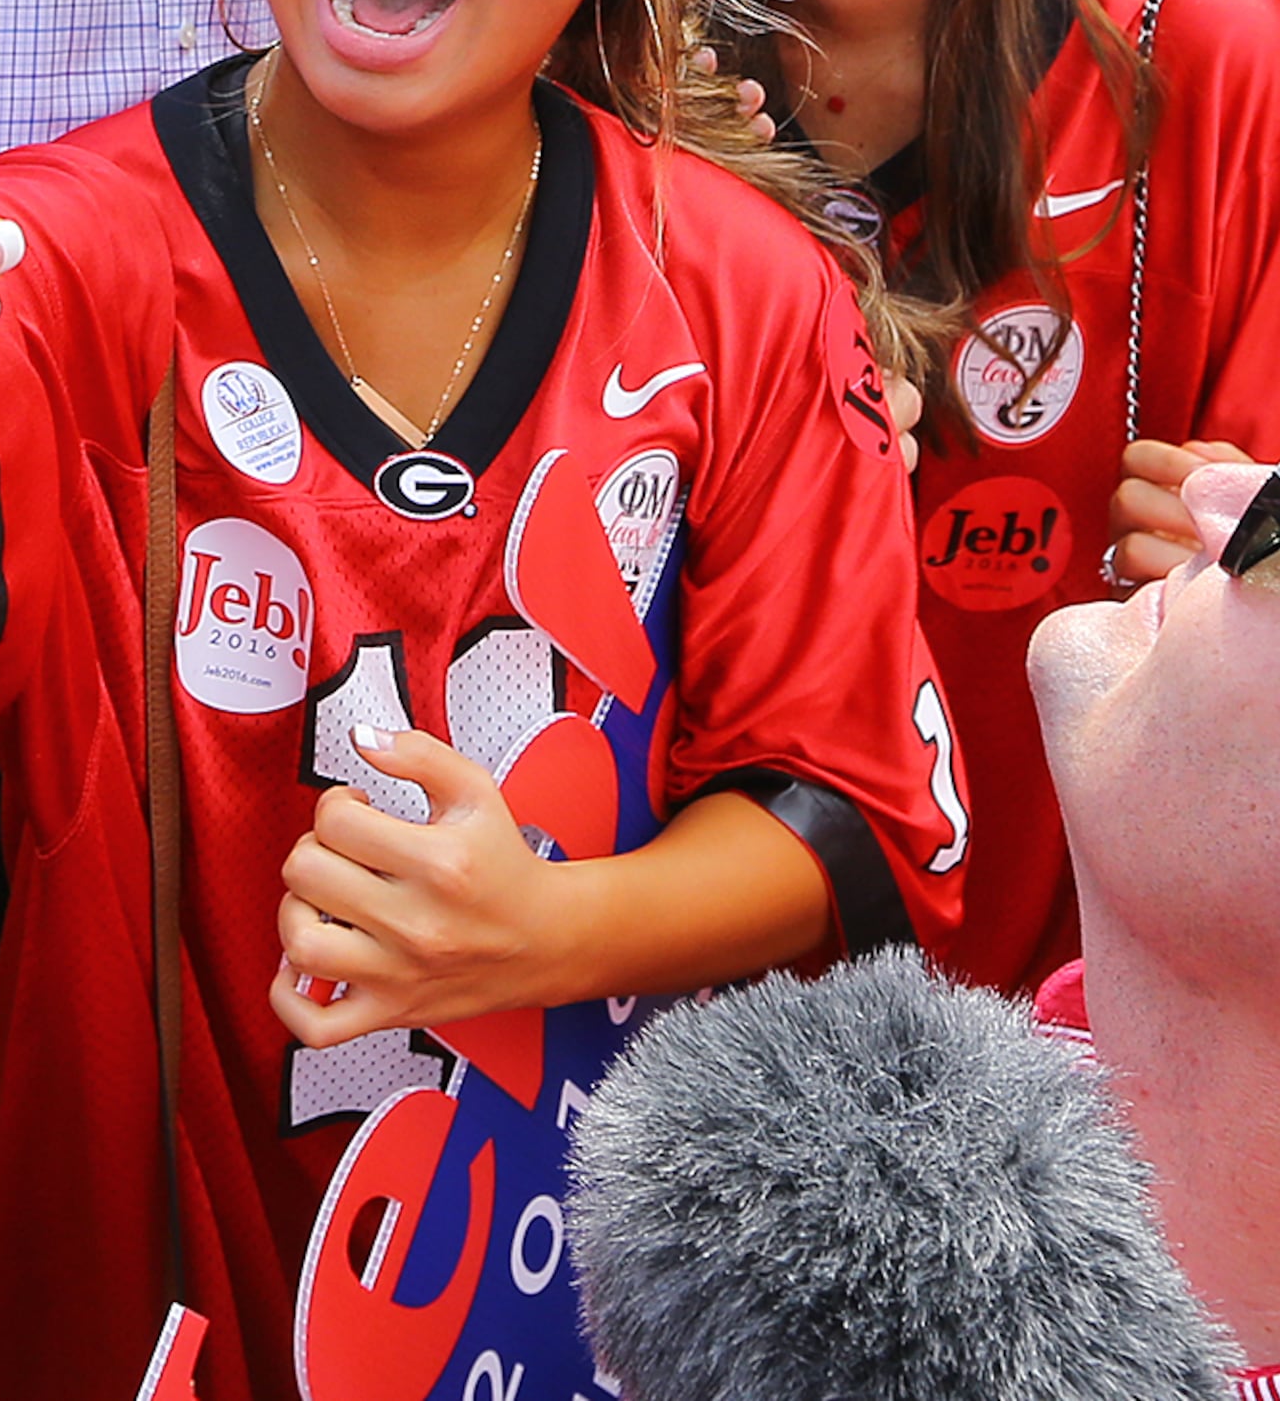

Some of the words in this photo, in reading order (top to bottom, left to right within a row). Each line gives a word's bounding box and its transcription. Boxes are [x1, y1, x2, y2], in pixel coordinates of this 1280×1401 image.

[235, 422, 289, 451] REPUBLICAN
[237, 410, 276, 434] COLLEGE
[379, 456, 469, 515] G
[926, 507, 1058, 574] Jeb!
[179, 550, 310, 671] Jeb!
[209, 629, 277, 660] 2016
